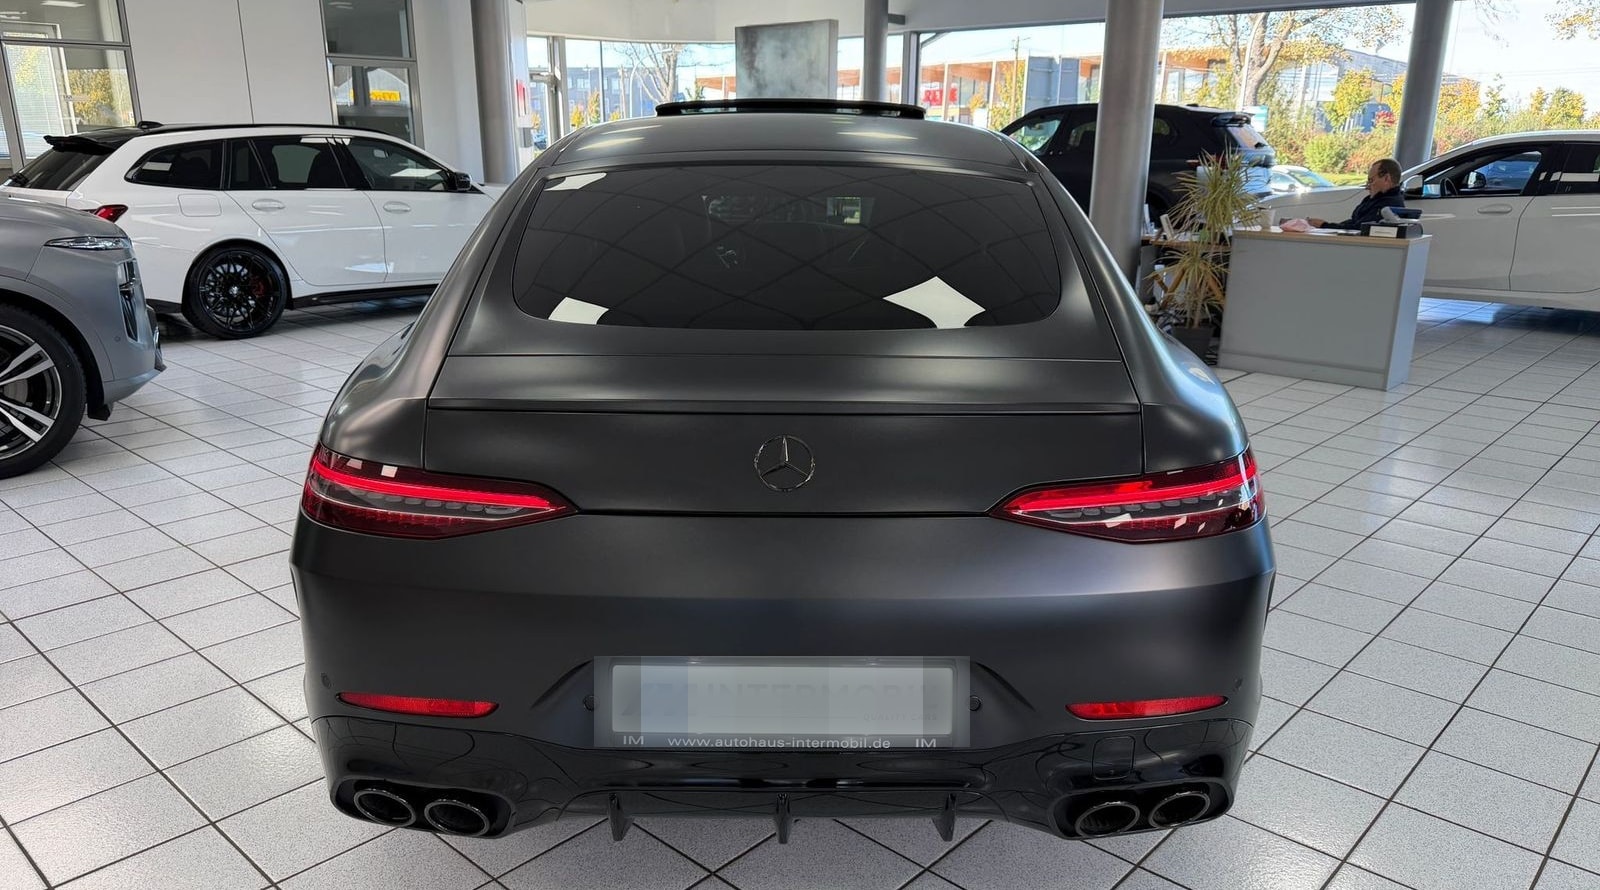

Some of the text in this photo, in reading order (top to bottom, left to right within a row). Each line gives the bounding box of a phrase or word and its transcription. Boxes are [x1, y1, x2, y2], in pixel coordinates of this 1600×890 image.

[623, 735, 937, 748] IM www.autohaus-intermobil.de IM
